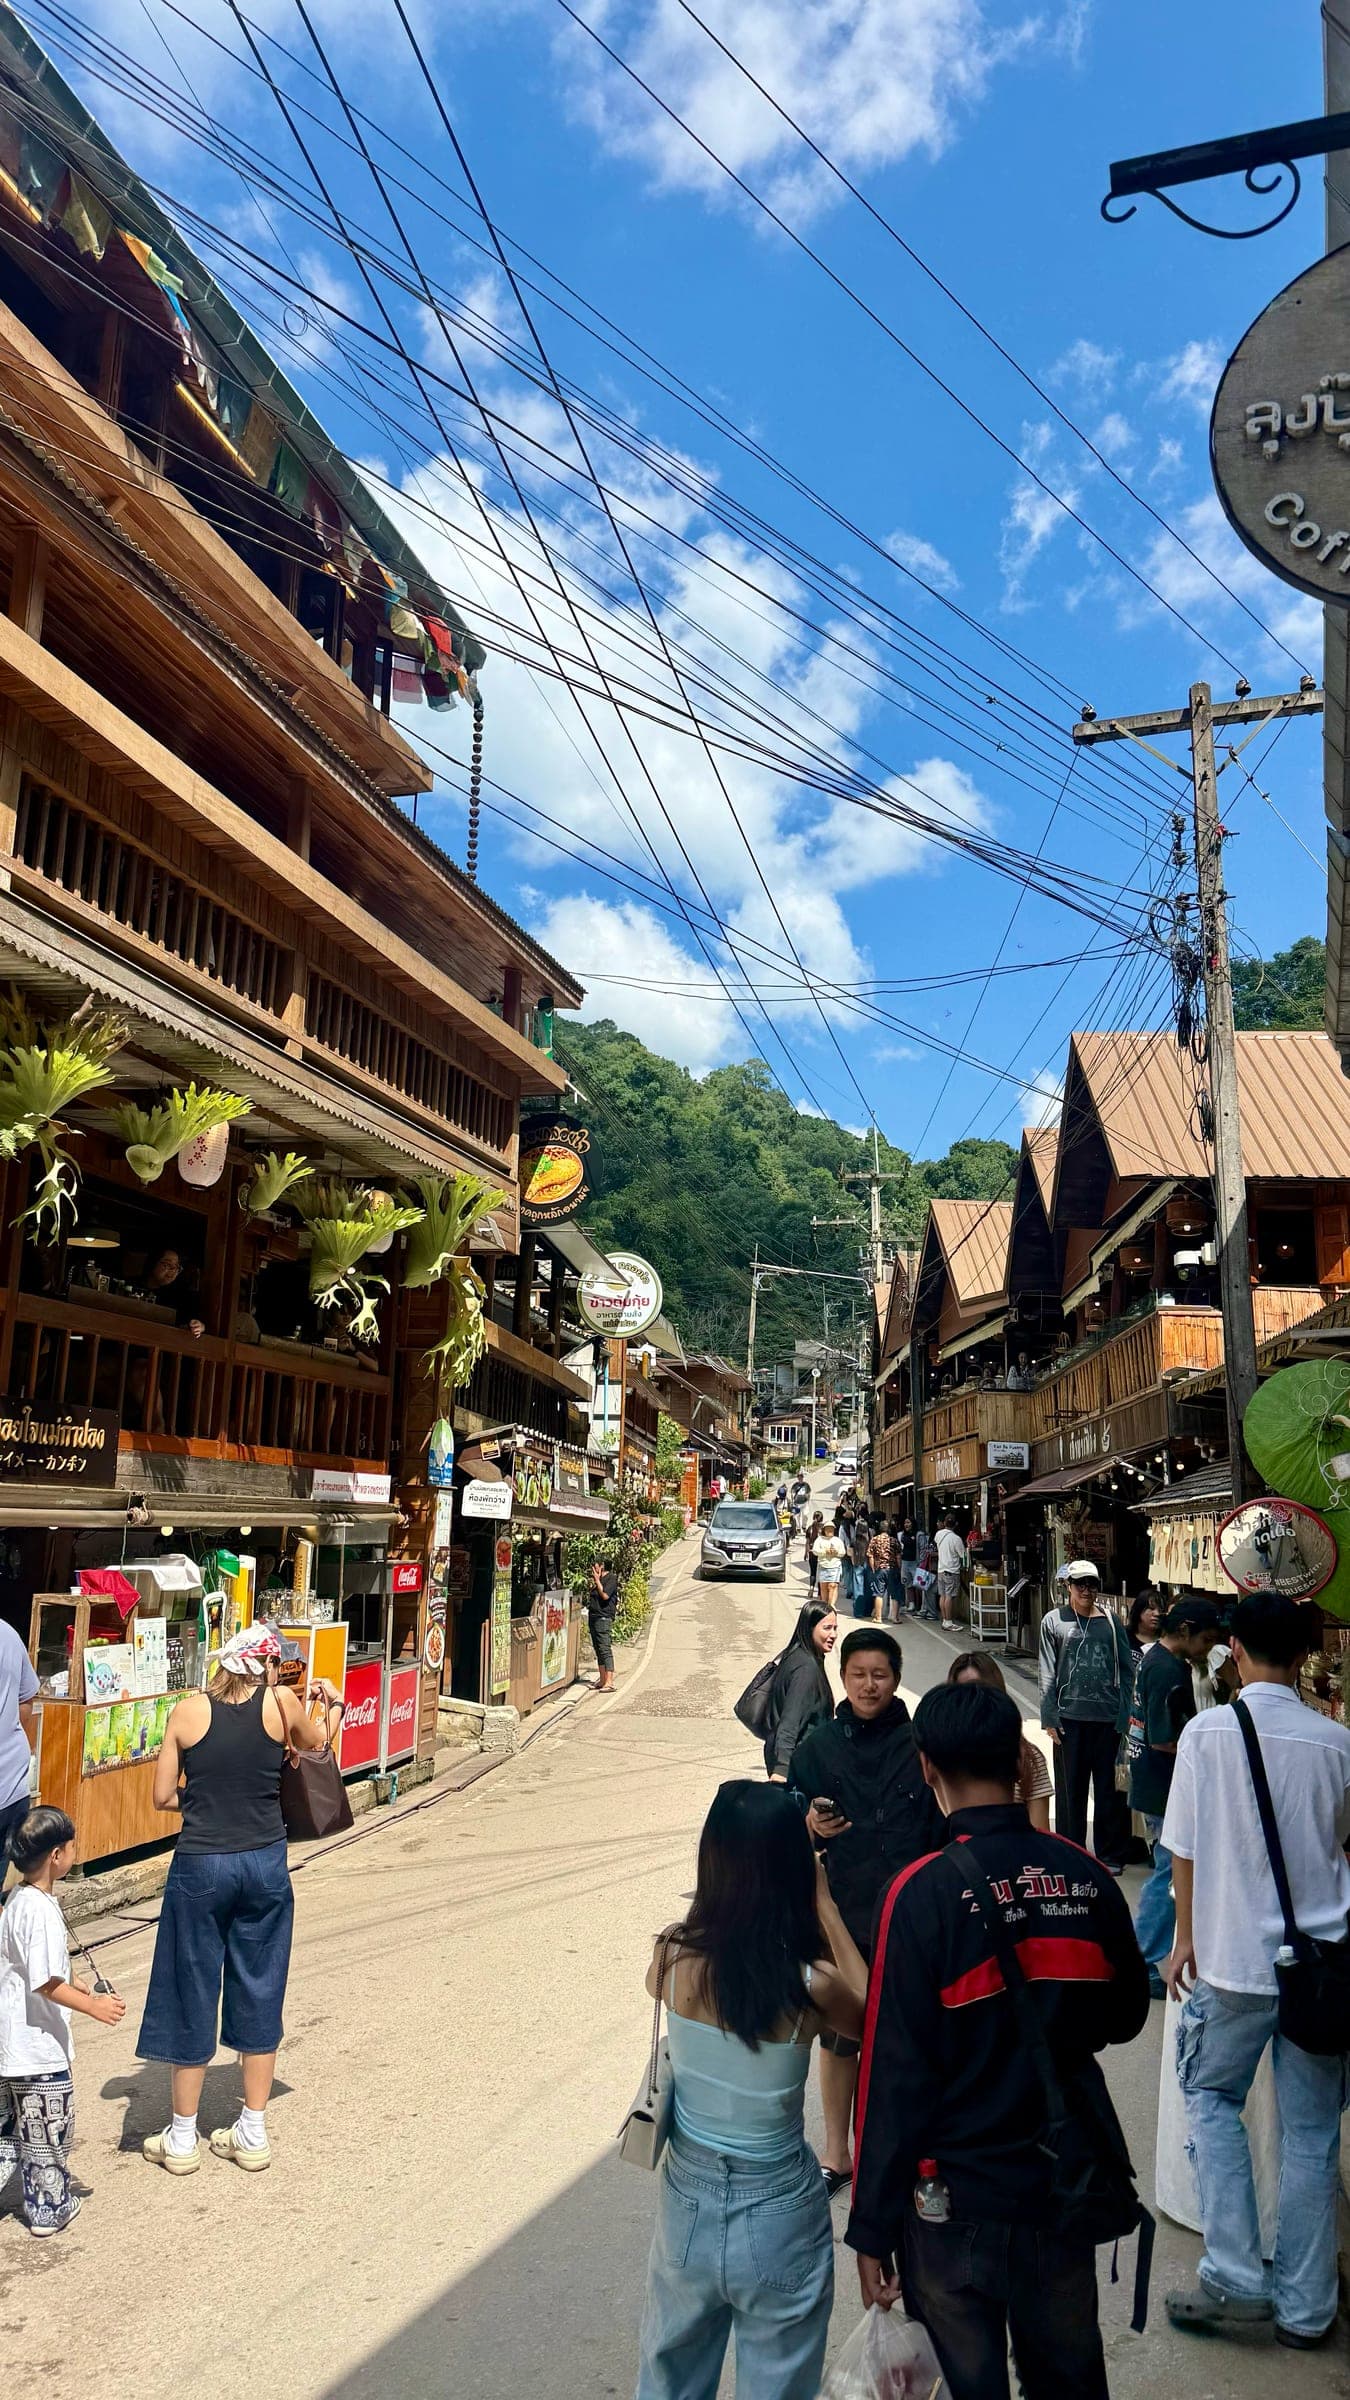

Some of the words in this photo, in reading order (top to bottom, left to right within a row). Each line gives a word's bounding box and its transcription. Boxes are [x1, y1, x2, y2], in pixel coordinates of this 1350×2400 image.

[520, 1185, 590, 1222] าดถูกหลักอนามัย
[0, 1405, 105, 1450] อยใจแม่กำปอง
[468, 1492, 506, 1504] ห้องพักว่าง
[398, 1567, 417, 1587] Coca-Cola
[342, 1696, 378, 1731] Coca-Cola
[391, 1697, 414, 1725] Coca-Cola
